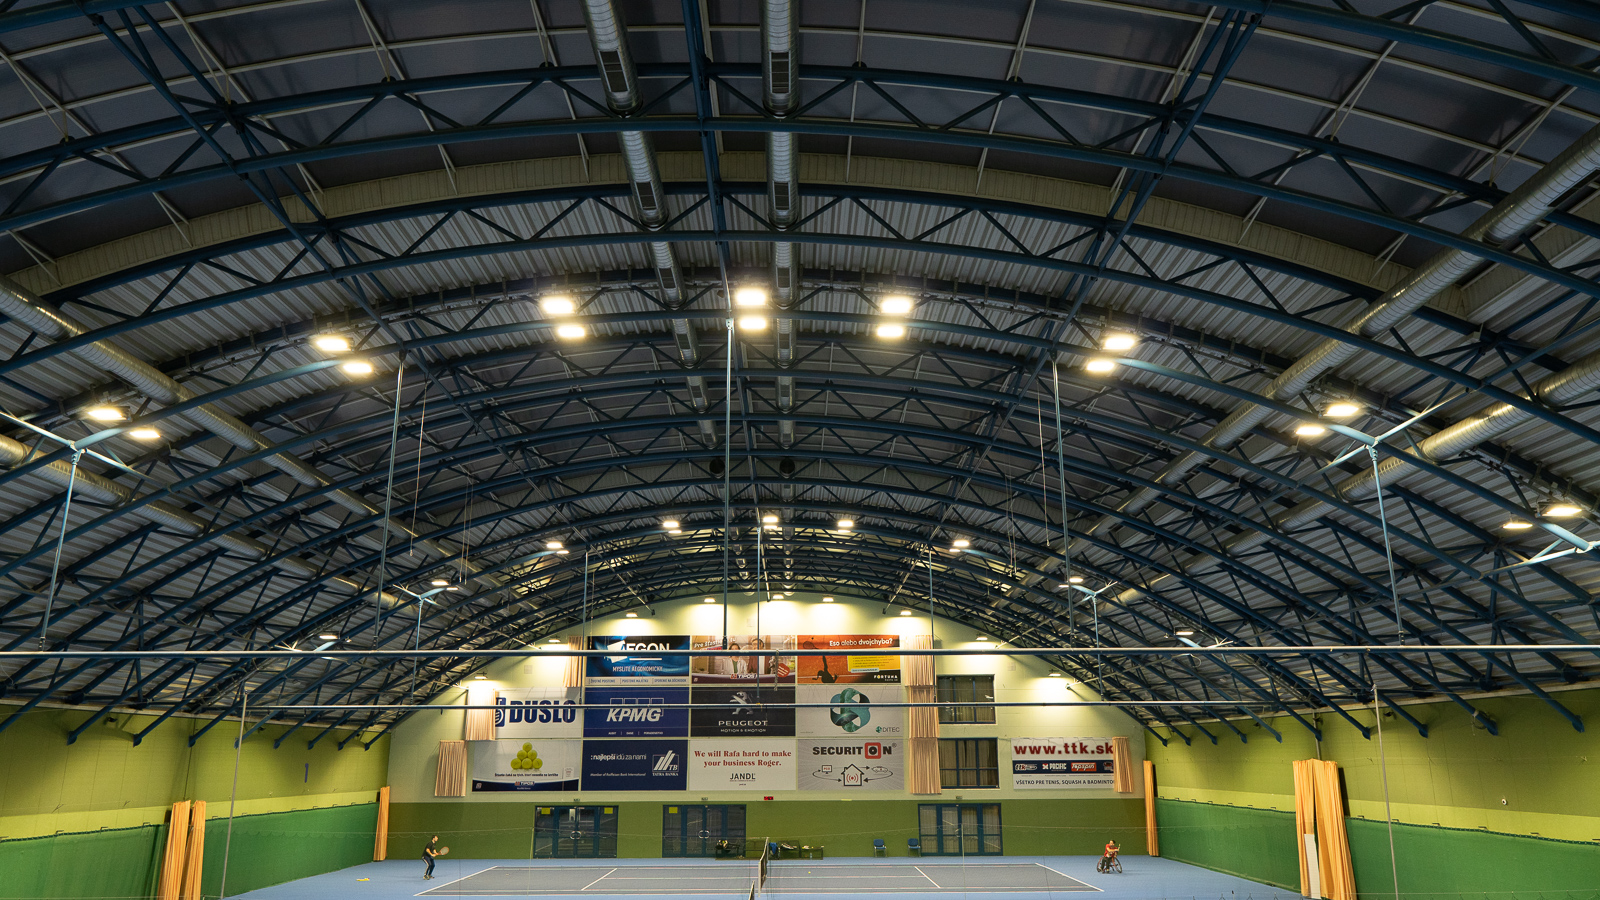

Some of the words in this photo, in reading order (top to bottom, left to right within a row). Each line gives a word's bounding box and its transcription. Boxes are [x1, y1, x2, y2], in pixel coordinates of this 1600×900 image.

[858, 638, 893, 646] dvojchyba?
[509, 700, 576, 723] DUSLO
[606, 707, 662, 722] KPMG
[1014, 742, 1113, 755] www.ttk.sk
[758, 760, 782, 768] Roger.
